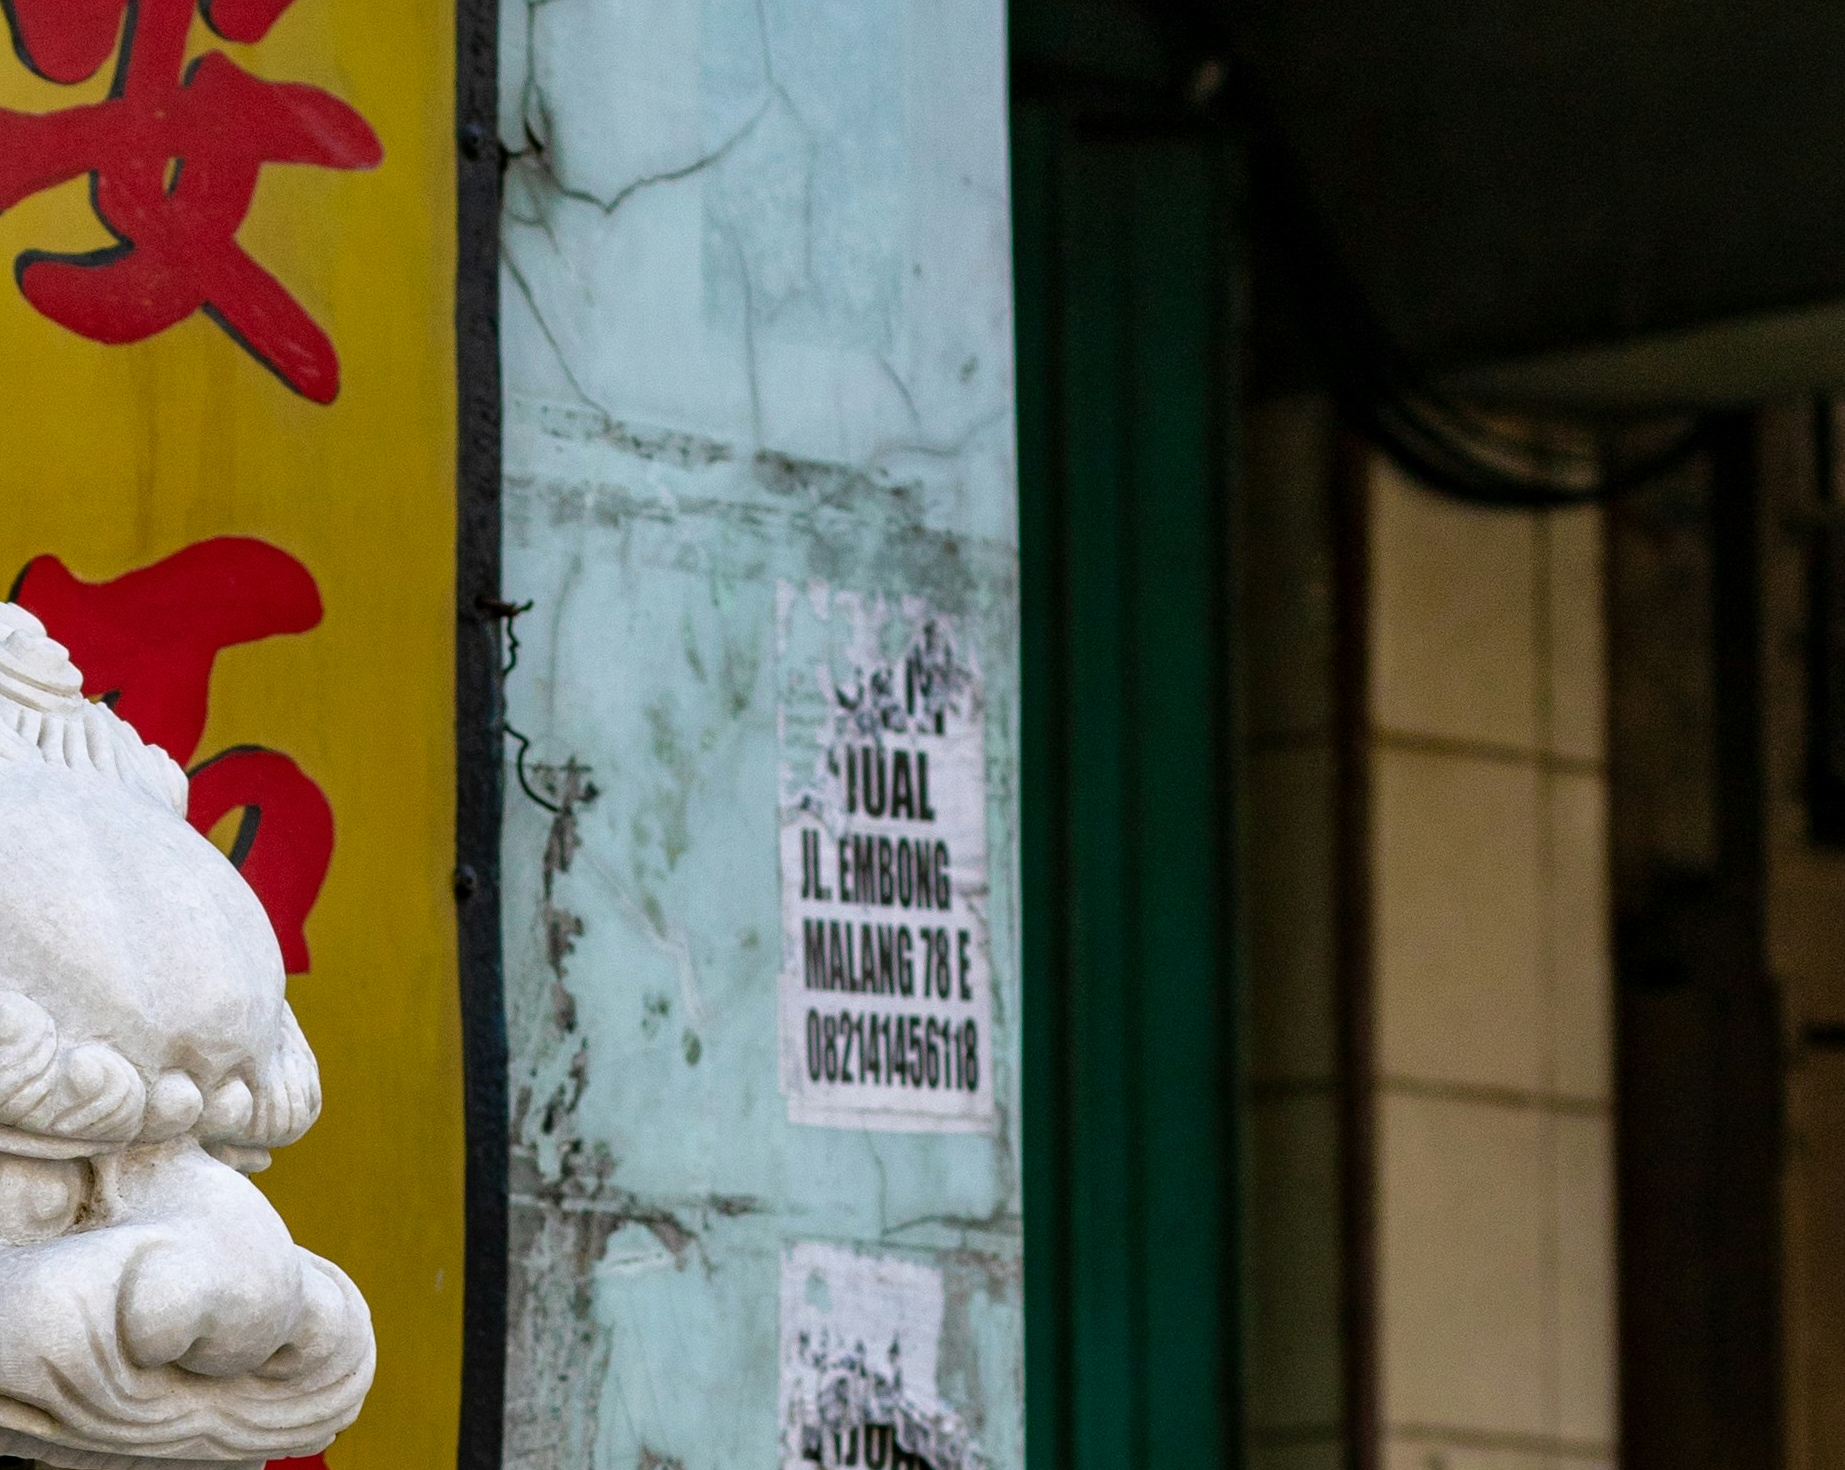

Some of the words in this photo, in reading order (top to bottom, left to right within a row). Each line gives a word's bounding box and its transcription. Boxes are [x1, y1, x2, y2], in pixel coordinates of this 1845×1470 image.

[839, 832, 951, 911] EMBONG
[803, 917, 913, 999] MALANG
[919, 925, 951, 1000] 78
[958, 928, 972, 1001] E
[806, 1006, 979, 1093] 082141456118
